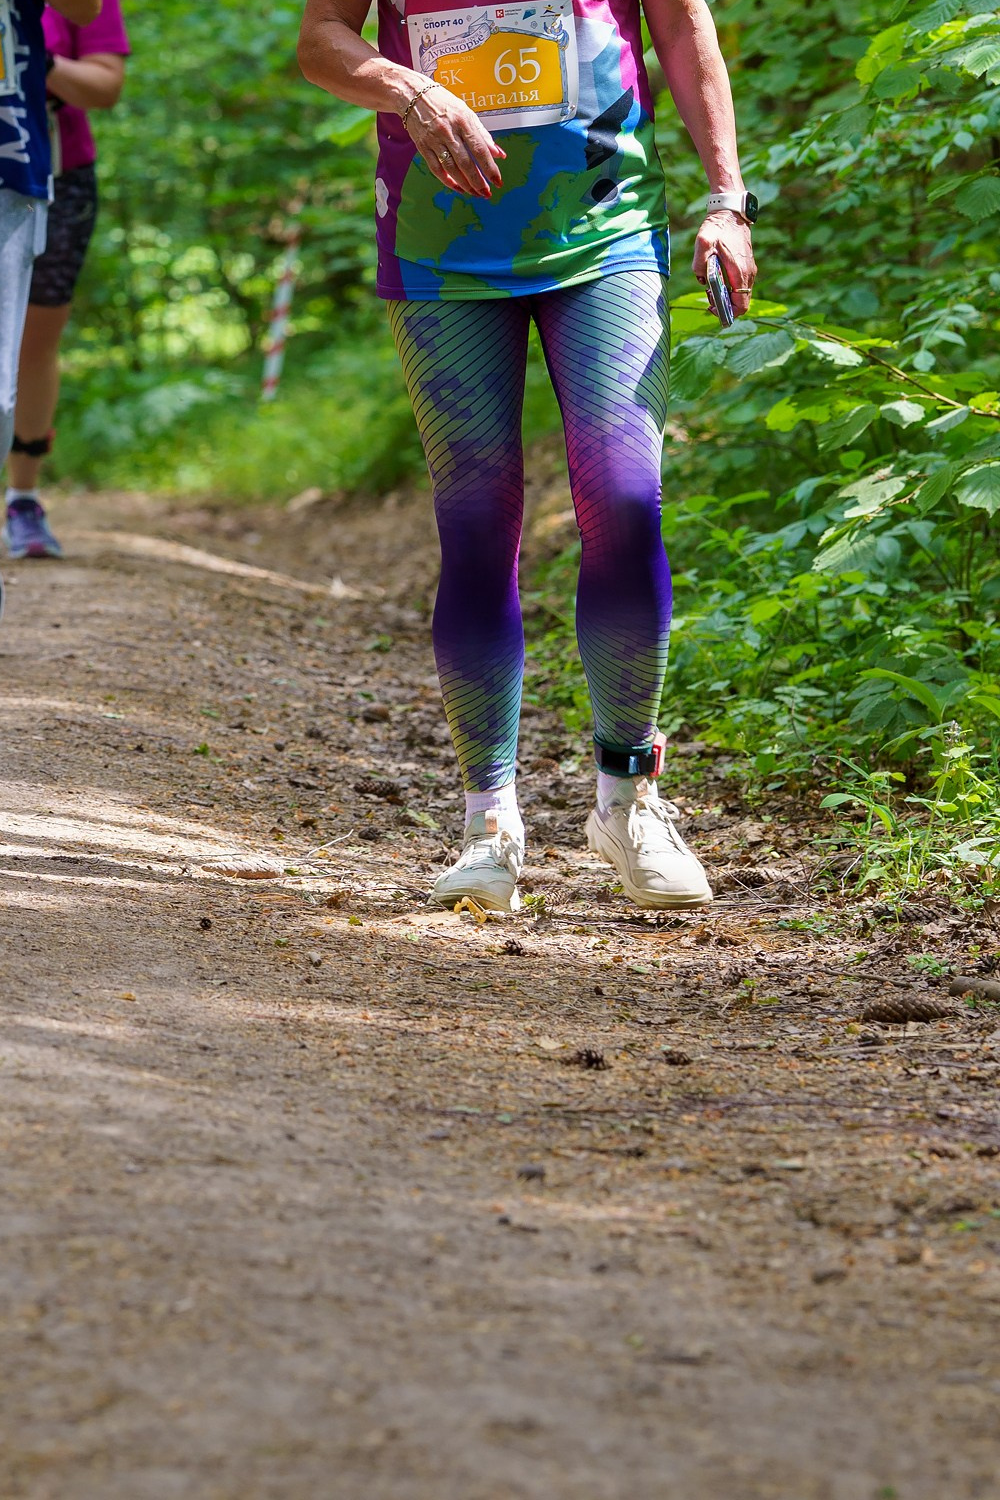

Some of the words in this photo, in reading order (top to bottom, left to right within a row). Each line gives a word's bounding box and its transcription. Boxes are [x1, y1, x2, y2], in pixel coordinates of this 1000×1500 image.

[423, 19, 451, 30] СПОРТ
[452, 18, 464, 26] 40
[427, 34, 485, 62] Лукоморье
[493, 47, 541, 86] 65
[462, 89, 540, 109] Наталья
